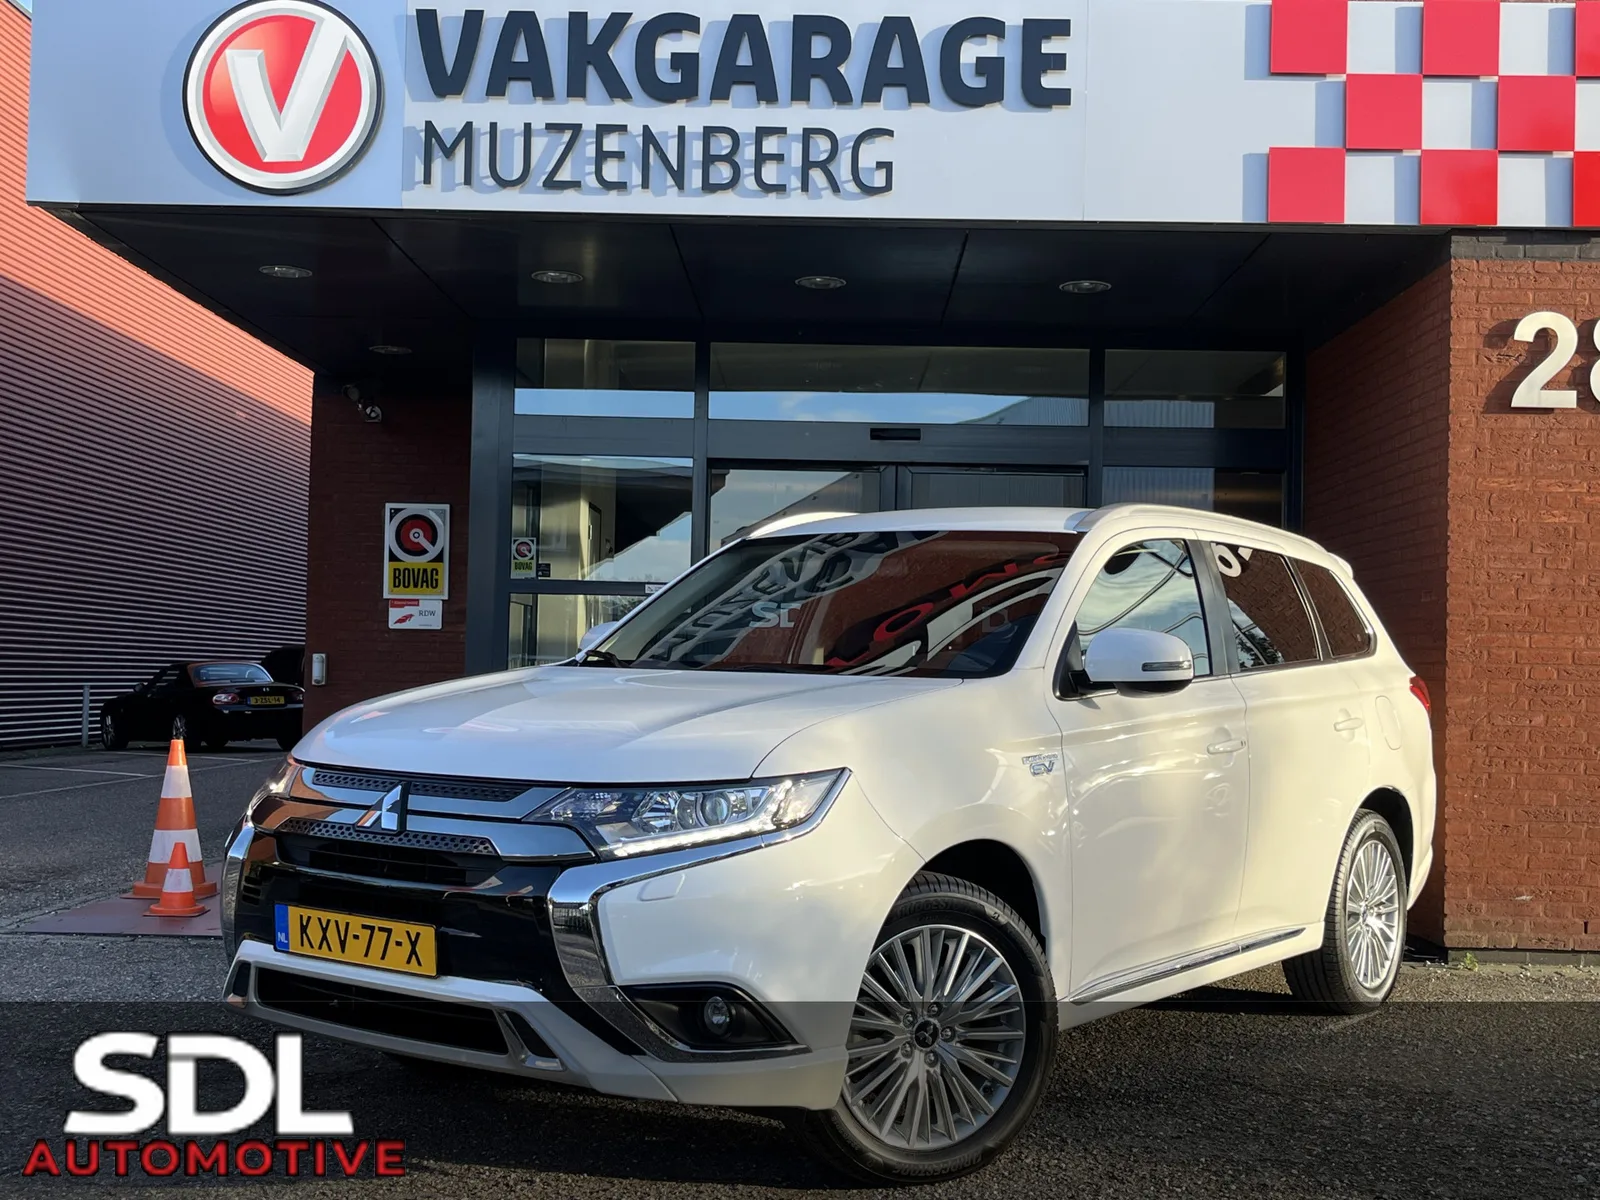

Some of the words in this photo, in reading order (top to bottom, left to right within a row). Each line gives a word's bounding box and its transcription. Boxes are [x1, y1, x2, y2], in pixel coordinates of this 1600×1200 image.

[415, 8, 1072, 108] VAKGARAGE
[422, 120, 895, 194] MUZENBERG
[1511, 311, 1600, 409] 2
[393, 567, 439, 589] BOVAG
[514, 561, 533, 571] BOVAG
[418, 609, 437, 617] RDW
[277, 931, 289, 943] NL
[299, 913, 423, 967] KXV-77-X
